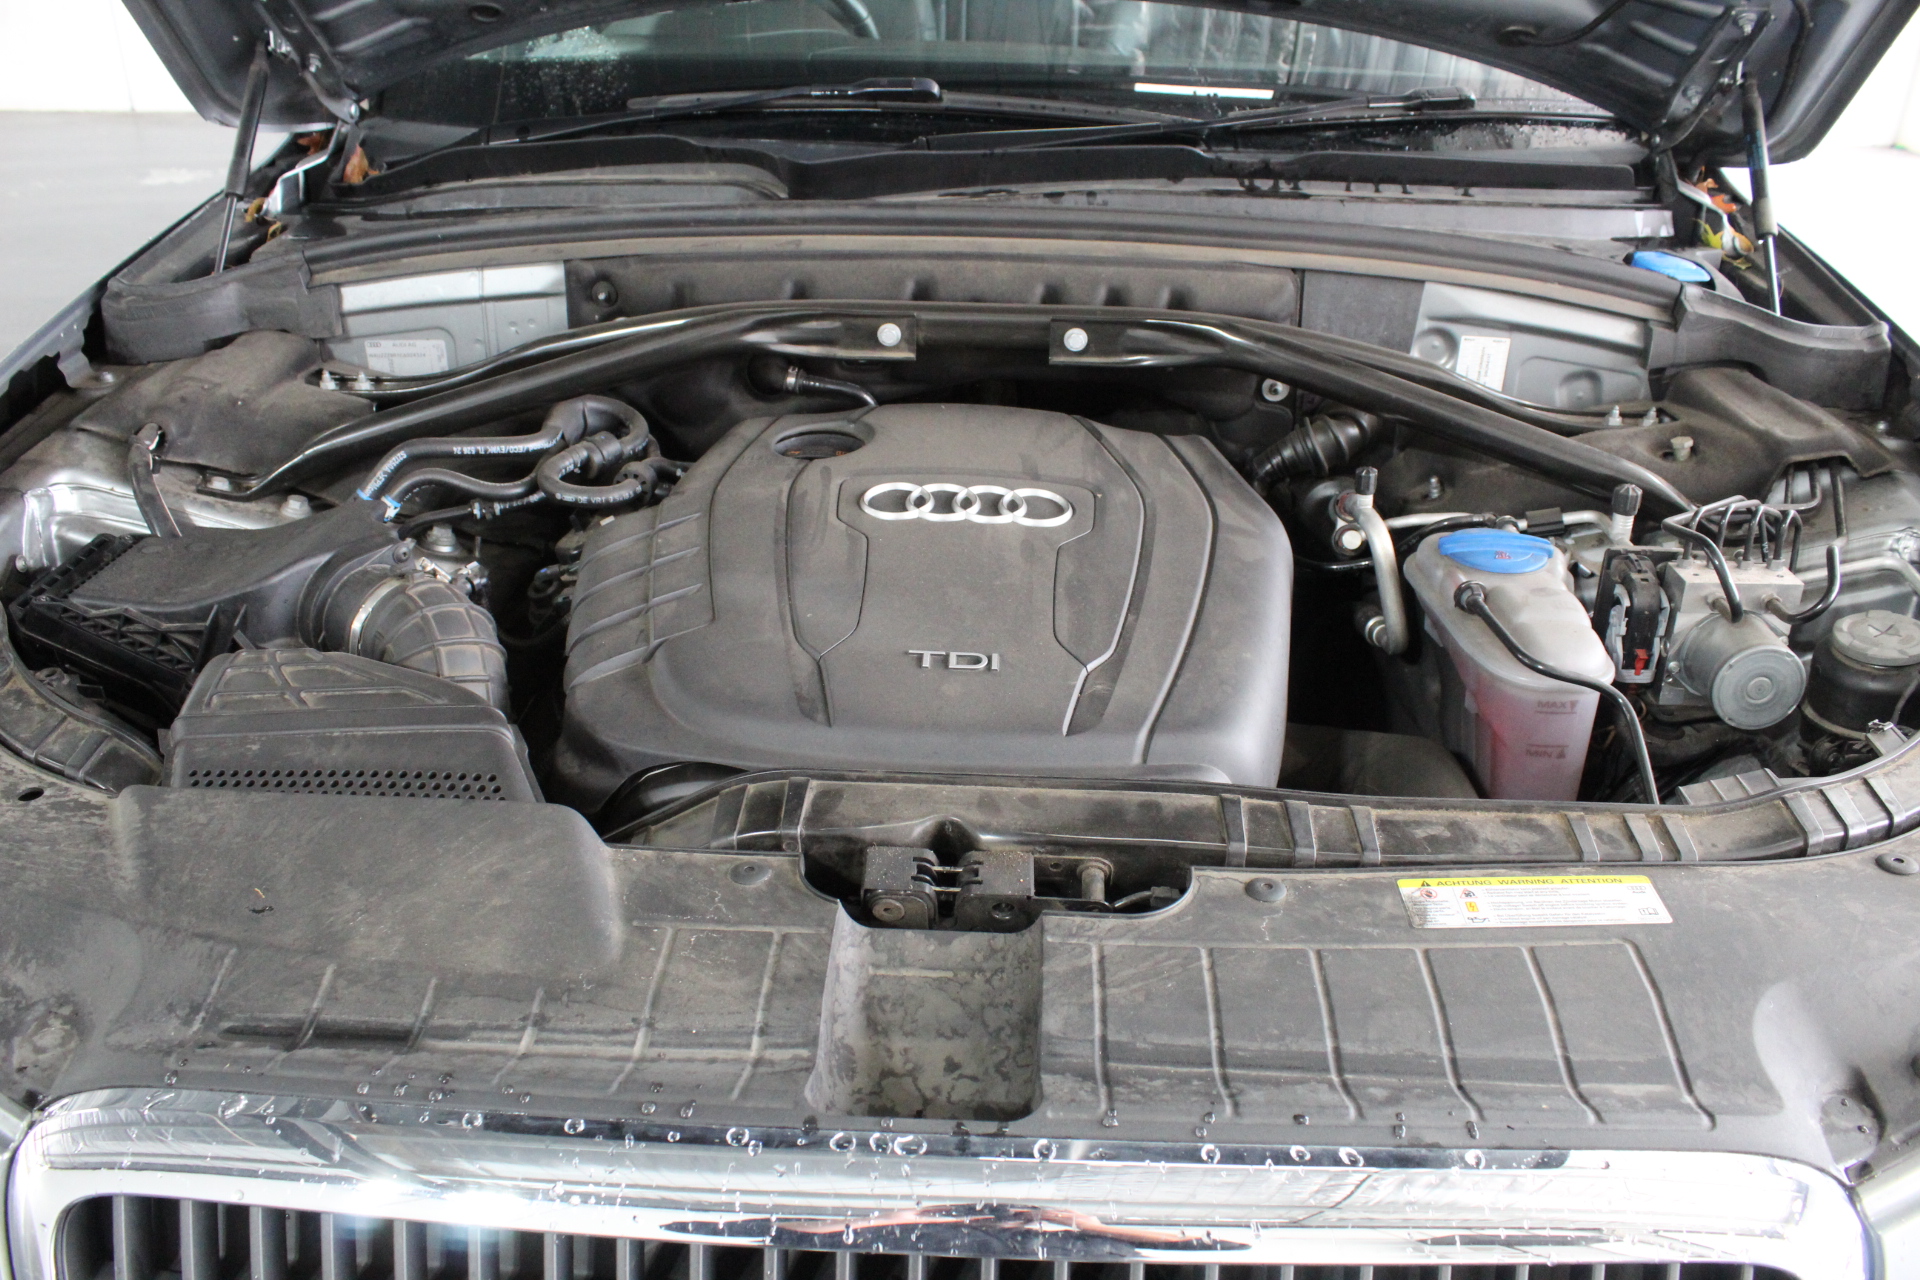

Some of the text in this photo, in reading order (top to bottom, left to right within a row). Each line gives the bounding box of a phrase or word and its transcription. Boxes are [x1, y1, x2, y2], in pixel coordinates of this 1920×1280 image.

[908, 650, 999, 671] TDI
[1537, 700, 1567, 709] MAX
[1525, 749, 1553, 758] MIN
